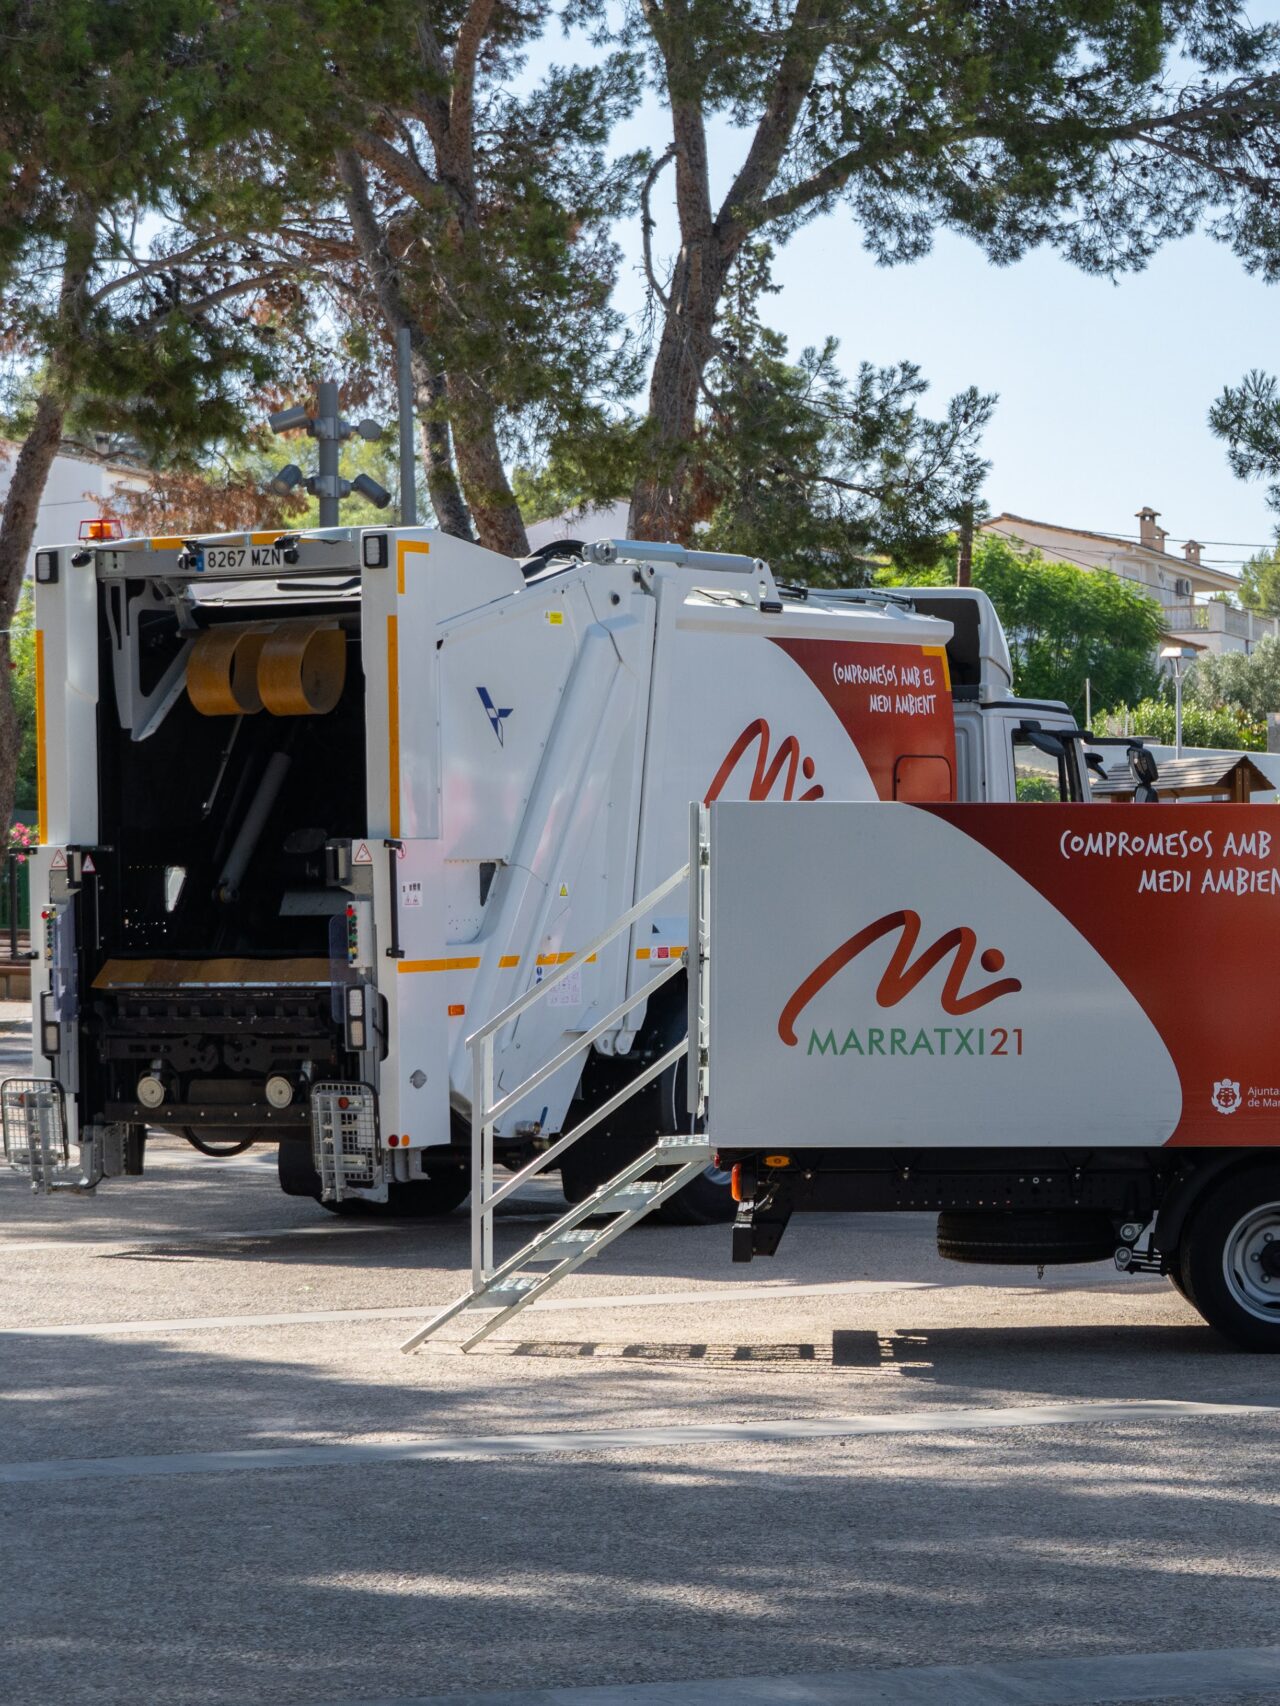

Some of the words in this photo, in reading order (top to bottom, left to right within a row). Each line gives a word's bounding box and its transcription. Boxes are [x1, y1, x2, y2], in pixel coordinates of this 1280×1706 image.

[208, 550, 246, 568] 8267
[251, 549, 281, 566] MZN
[833, 662, 898, 687] COMPROMESOS
[901, 666, 920, 688] AMB
[923, 668, 935, 686] EL
[869, 694, 892, 713] MEDI
[895, 693, 937, 716] AMBIENT
[1060, 830, 1213, 859] COMPROMESOS
[1223, 830, 1272, 859] AMB
[1138, 869, 1191, 893] MEDI
[1247, 1098, 1260, 1107] de
